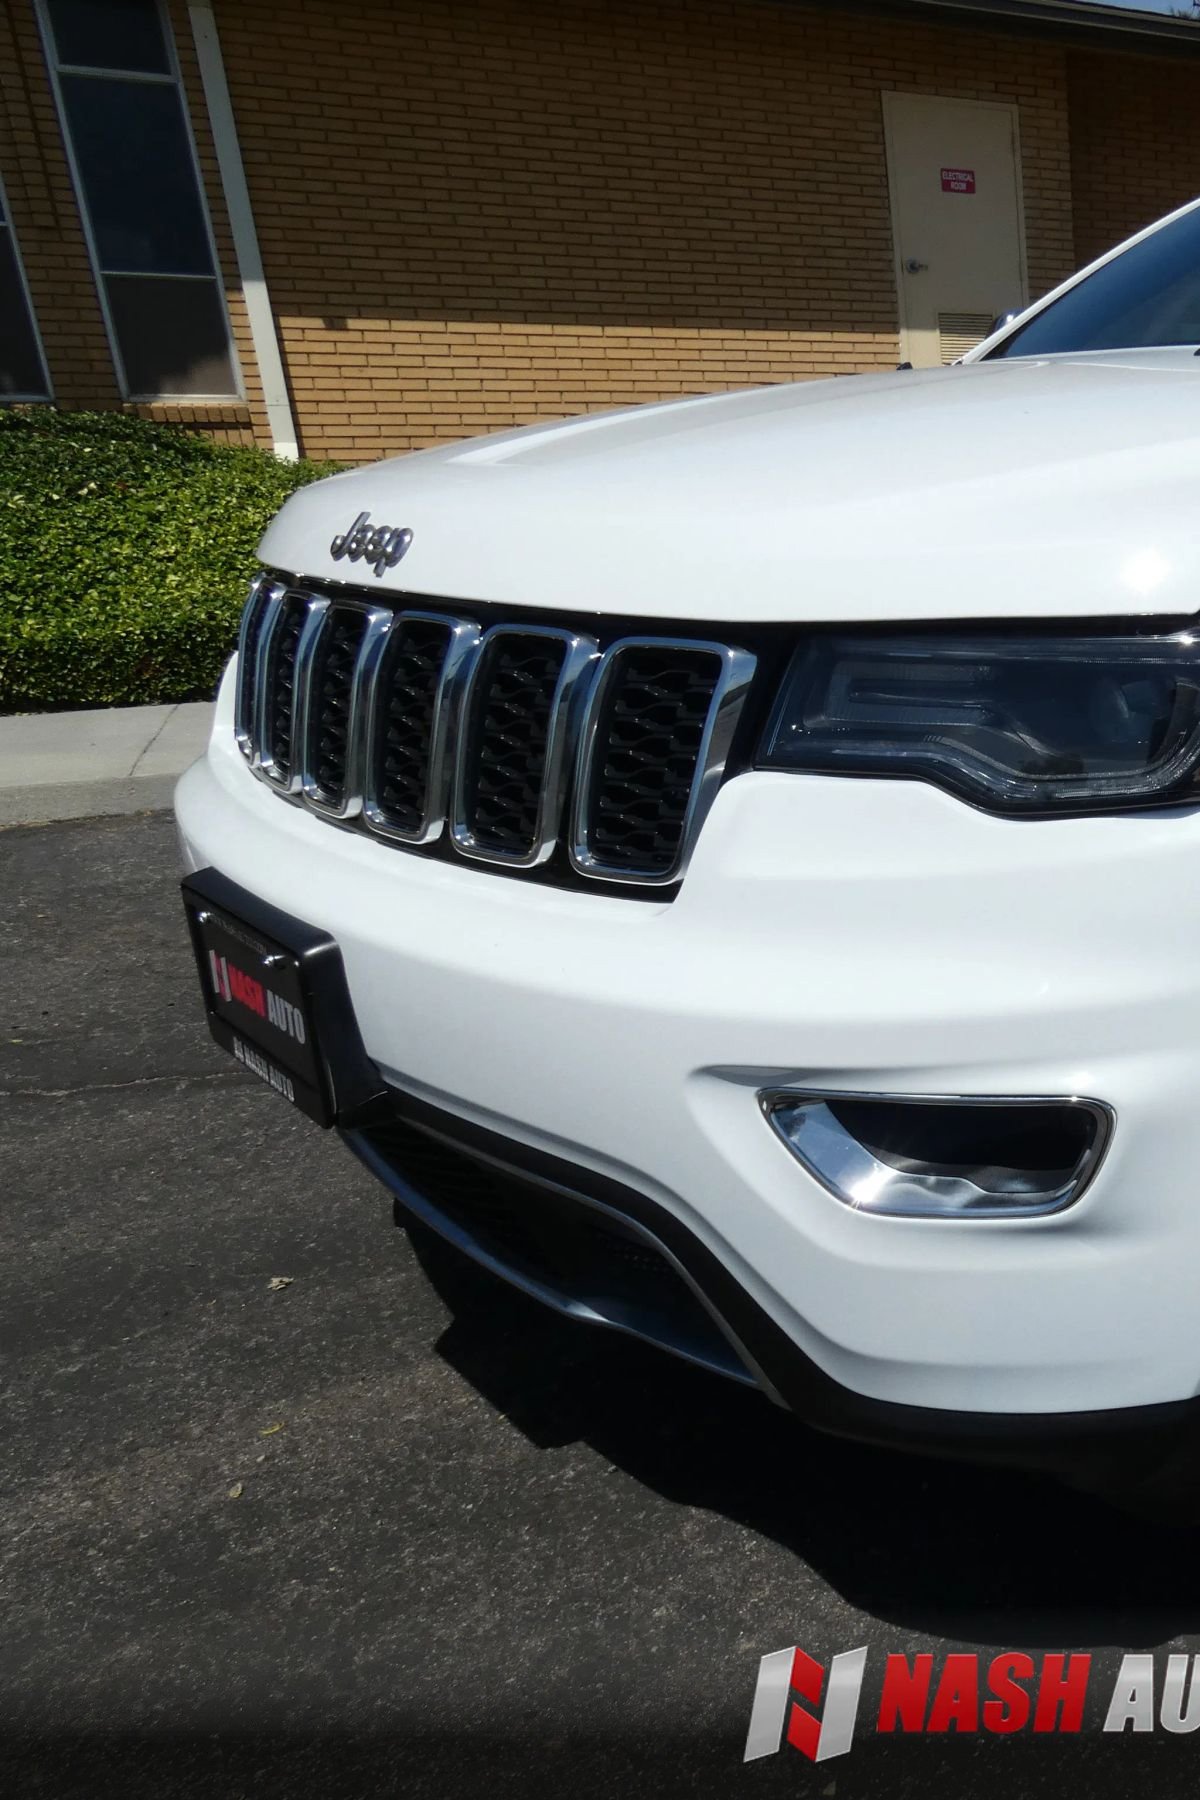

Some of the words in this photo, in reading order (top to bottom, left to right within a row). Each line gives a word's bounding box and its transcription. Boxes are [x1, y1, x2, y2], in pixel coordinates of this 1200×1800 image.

[330, 511, 414, 578] Jeep
[228, 962, 266, 1018] NASH
[267, 989, 306, 1045] AUTO
